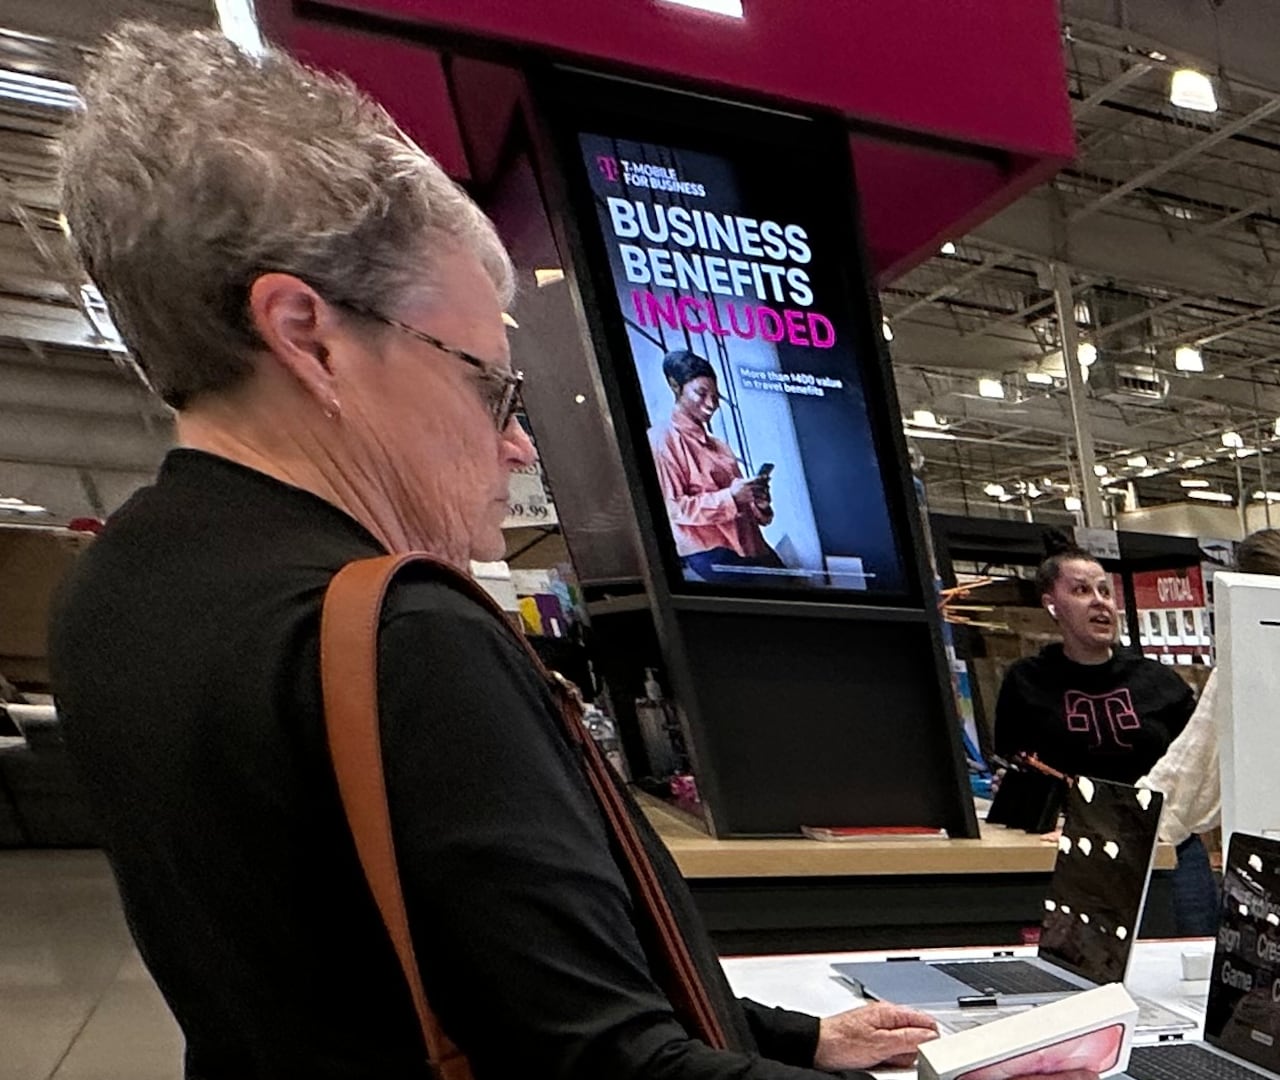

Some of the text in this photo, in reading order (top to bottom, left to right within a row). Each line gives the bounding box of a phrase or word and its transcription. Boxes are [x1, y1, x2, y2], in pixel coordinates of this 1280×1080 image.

[621, 160, 676, 180] T-MOBILE
[624, 172, 706, 197] FOR BUSINESS
[607, 196, 812, 264] BUSINESS
[619, 243, 814, 306] BENEFITS
[631, 289, 836, 349] INCLUDED
[1157, 576, 1193, 602] OPTICAL
[1221, 960, 1252, 991] Game
